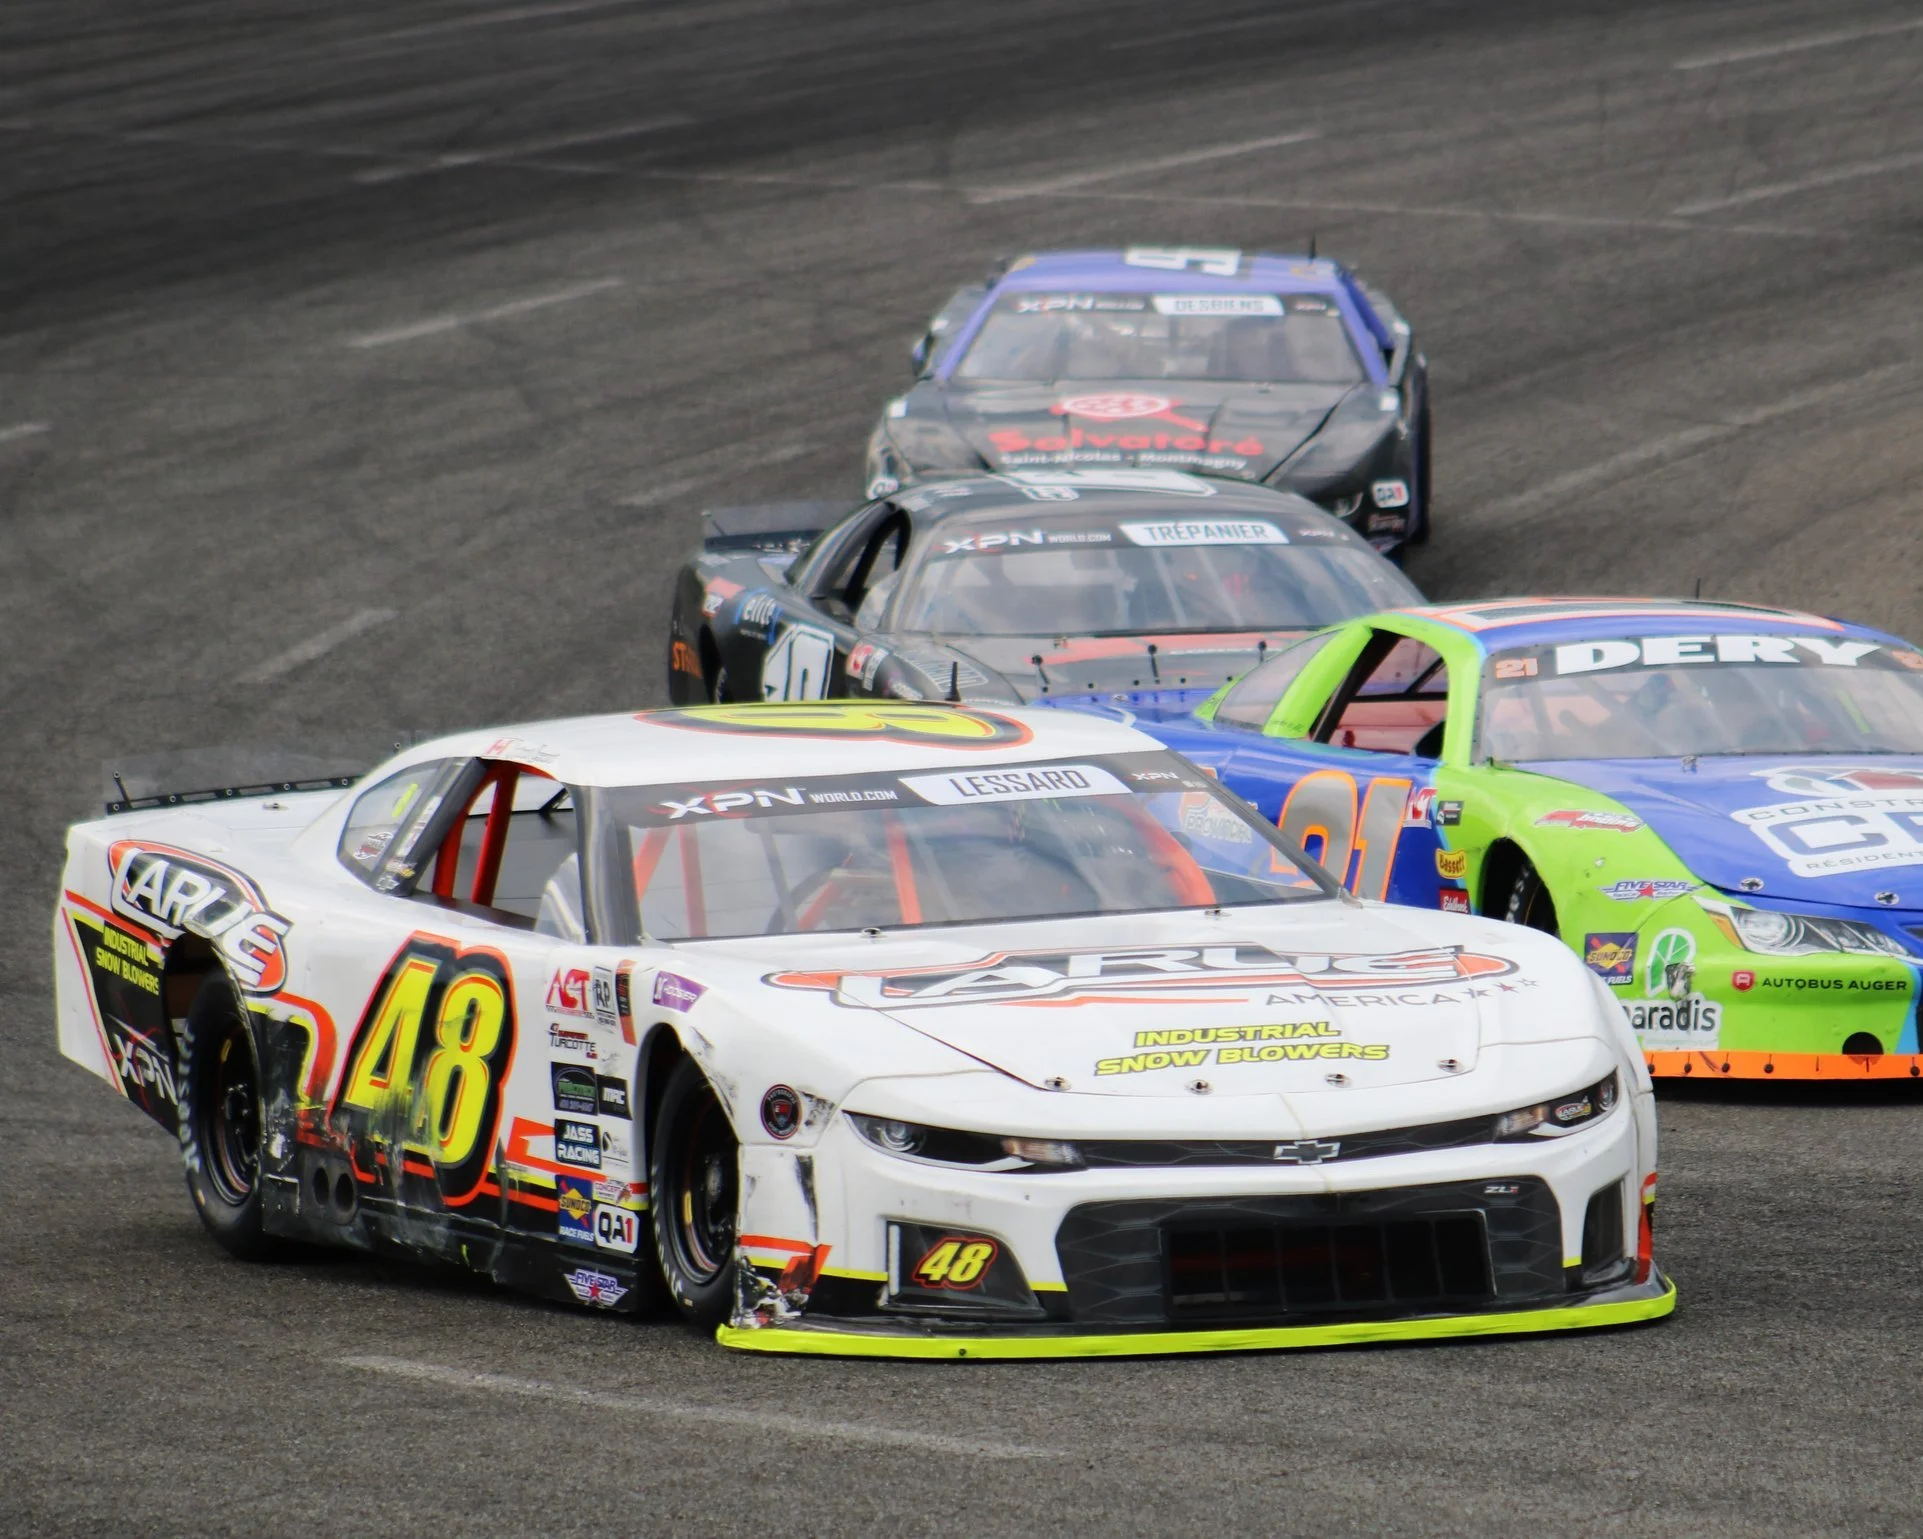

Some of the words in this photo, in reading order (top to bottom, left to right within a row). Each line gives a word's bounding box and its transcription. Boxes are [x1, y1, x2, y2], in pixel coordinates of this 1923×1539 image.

[1174, 299, 1264, 313] DESBIENS
[943, 528, 1044, 554] XPN
[1144, 521, 1269, 543] TRÉPANIER
[1554, 634, 1883, 676] DERY
[1495, 657, 1538, 680] 21
[947, 769, 1093, 799] LESSARD
[668, 786, 806, 820] XPN
[810, 788, 899, 805] WORLD.COM
[1614, 881, 1651, 893] FIVE
[1653, 881, 1688, 893] STAR
[102, 926, 149, 967] INDUSTRIAL
[1588, 949, 1633, 965] SUNOCO
[95, 946, 121, 976] SNOW
[121, 962, 161, 996] BLOWERS
[838, 945, 1463, 1007] LARUE
[1762, 977, 1844, 990] AUTOBUS
[1848, 980, 1908, 991] AUGER
[1264, 990, 1457, 1009] AMERICA
[1134, 1020, 1342, 1047] INDUSTRIAL
[342, 956, 506, 1164] 48
[1093, 1050, 1191, 1077] SNOW
[1195, 1041, 1391, 1067] BLOWERS
[563, 1125, 594, 1144] JASS
[557, 1143, 600, 1165] RACING
[560, 1198, 592, 1214] SUNOCO
[559, 1226, 577, 1238] RACE
[577, 1229, 595, 1242] FUELS
[599, 1211, 633, 1244] QA1
[917, 1240, 994, 1284] 48
